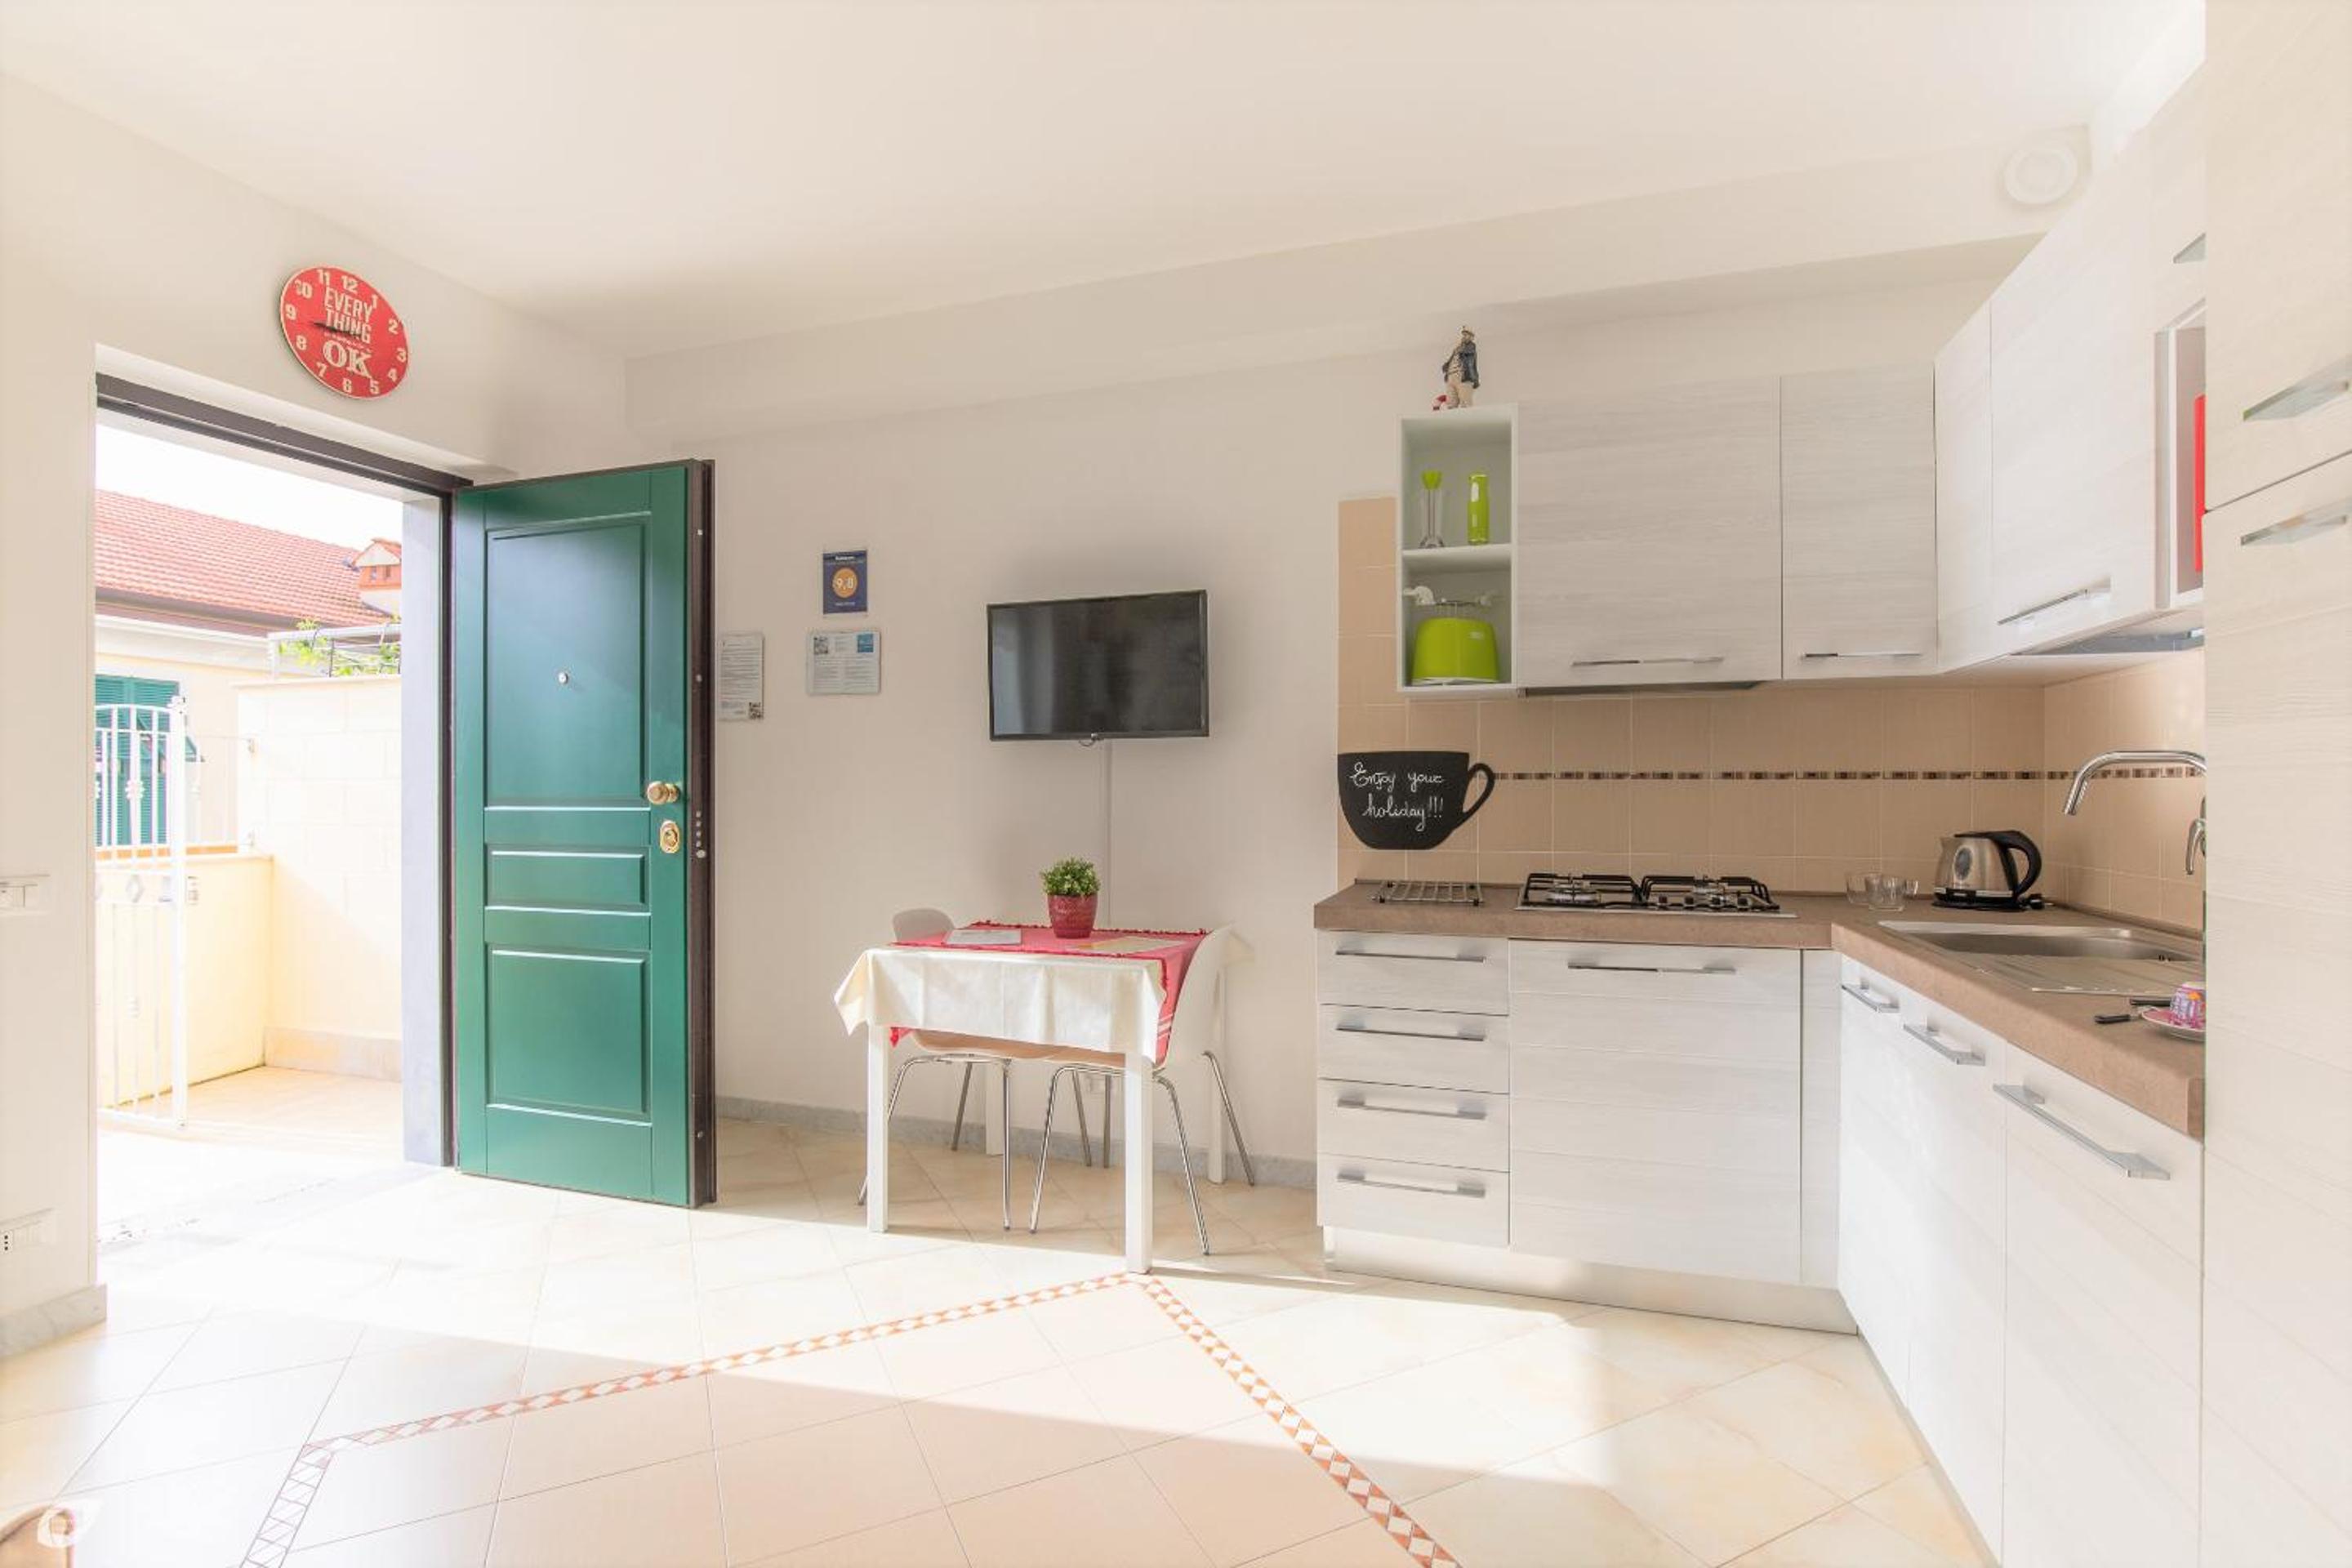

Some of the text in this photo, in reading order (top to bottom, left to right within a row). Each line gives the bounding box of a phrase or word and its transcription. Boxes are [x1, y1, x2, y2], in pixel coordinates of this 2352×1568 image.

[318, 270, 330, 287] 11
[341, 276, 358, 293] 12
[324, 287, 372, 323] EVERY
[372, 295, 378, 309] 1
[286, 304, 296, 320] 9
[325, 308, 371, 344] THING
[389, 318, 399, 335] 2
[296, 336, 307, 350] 8
[323, 340, 372, 380] OK
[397, 348, 407, 363] 3
[317, 362, 328, 377] 7
[388, 368, 397, 381] 4
[343, 378, 352, 393] 6
[369, 380, 380, 394] 5
[1350, 762, 1444, 792] Enjoy your
